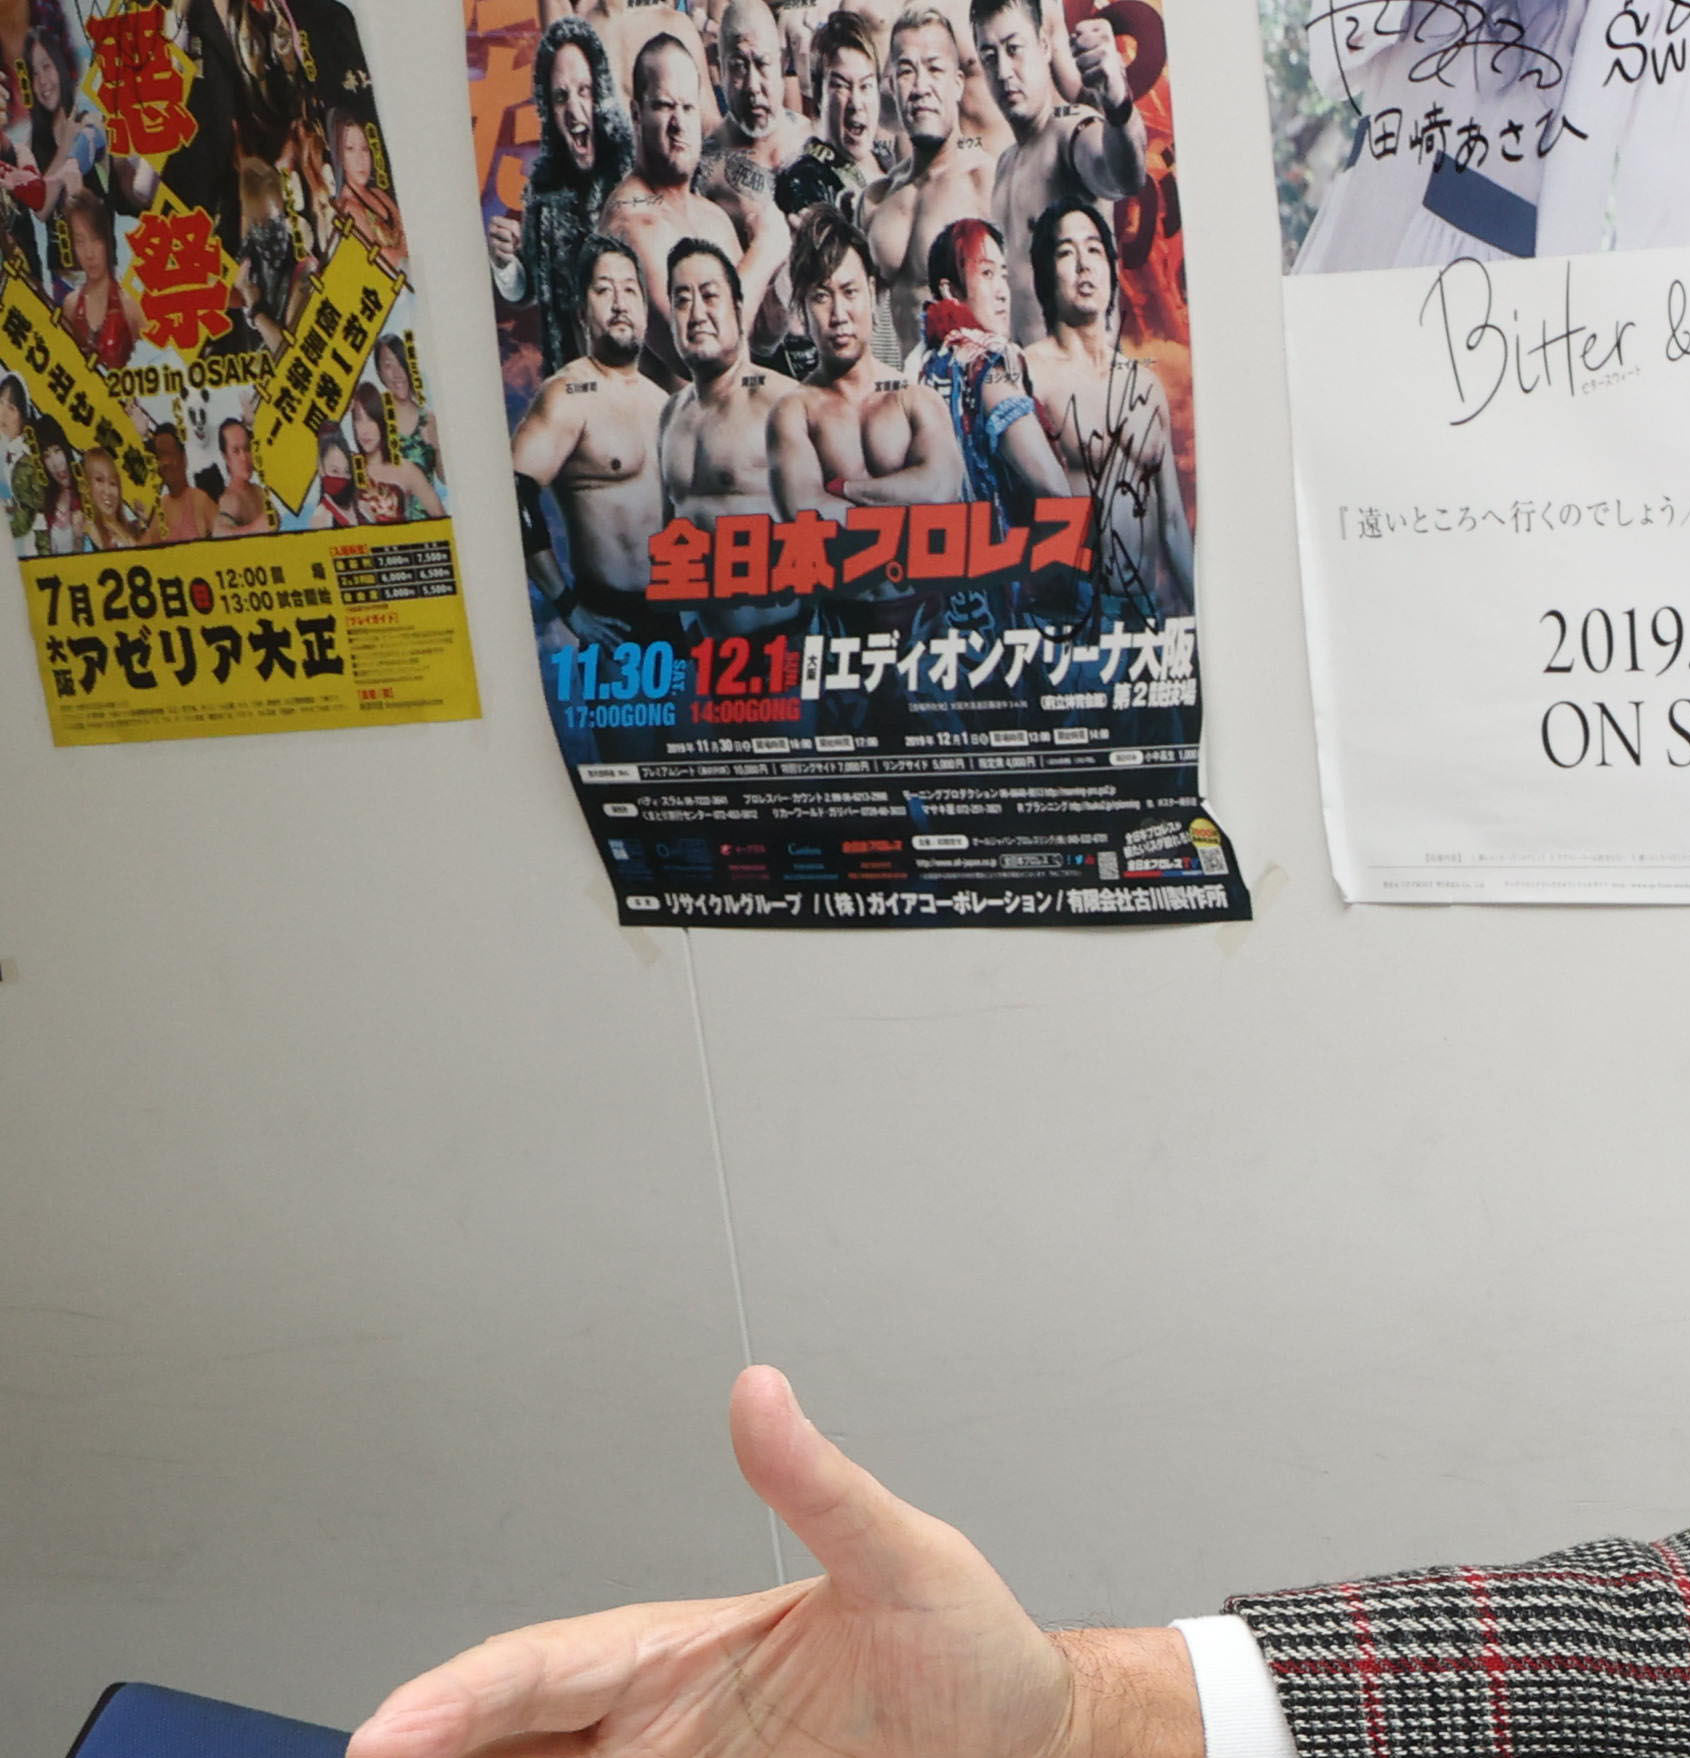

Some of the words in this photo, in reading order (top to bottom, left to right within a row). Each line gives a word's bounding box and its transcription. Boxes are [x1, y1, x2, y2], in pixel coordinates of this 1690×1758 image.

[1367, 103, 1589, 170] 田崎あさひ
[1420, 256, 1645, 426] Bitter
[108, 366, 161, 397] 2019
[164, 365, 184, 392] in
[187, 346, 275, 391] OSAKA
[214, 566, 267, 590] 12:00
[645, 497, 1094, 602] 全日本プロレス
[220, 592, 274, 614] 13:00
[69, 614, 345, 694] アゼリア大正
[552, 642, 672, 701] 11.30
[691, 637, 785, 697] 12.1
[827, 618, 1196, 693] エディオンアリーナ大阪
[564, 700, 676, 729] 17:00GONG
[689, 697, 800, 725] 14:00GONG
[1541, 701, 1644, 769] ON
[663, 891, 803, 916] リサイクルグループ
[1067, 885, 1227, 912] 有限会社古川製作所
